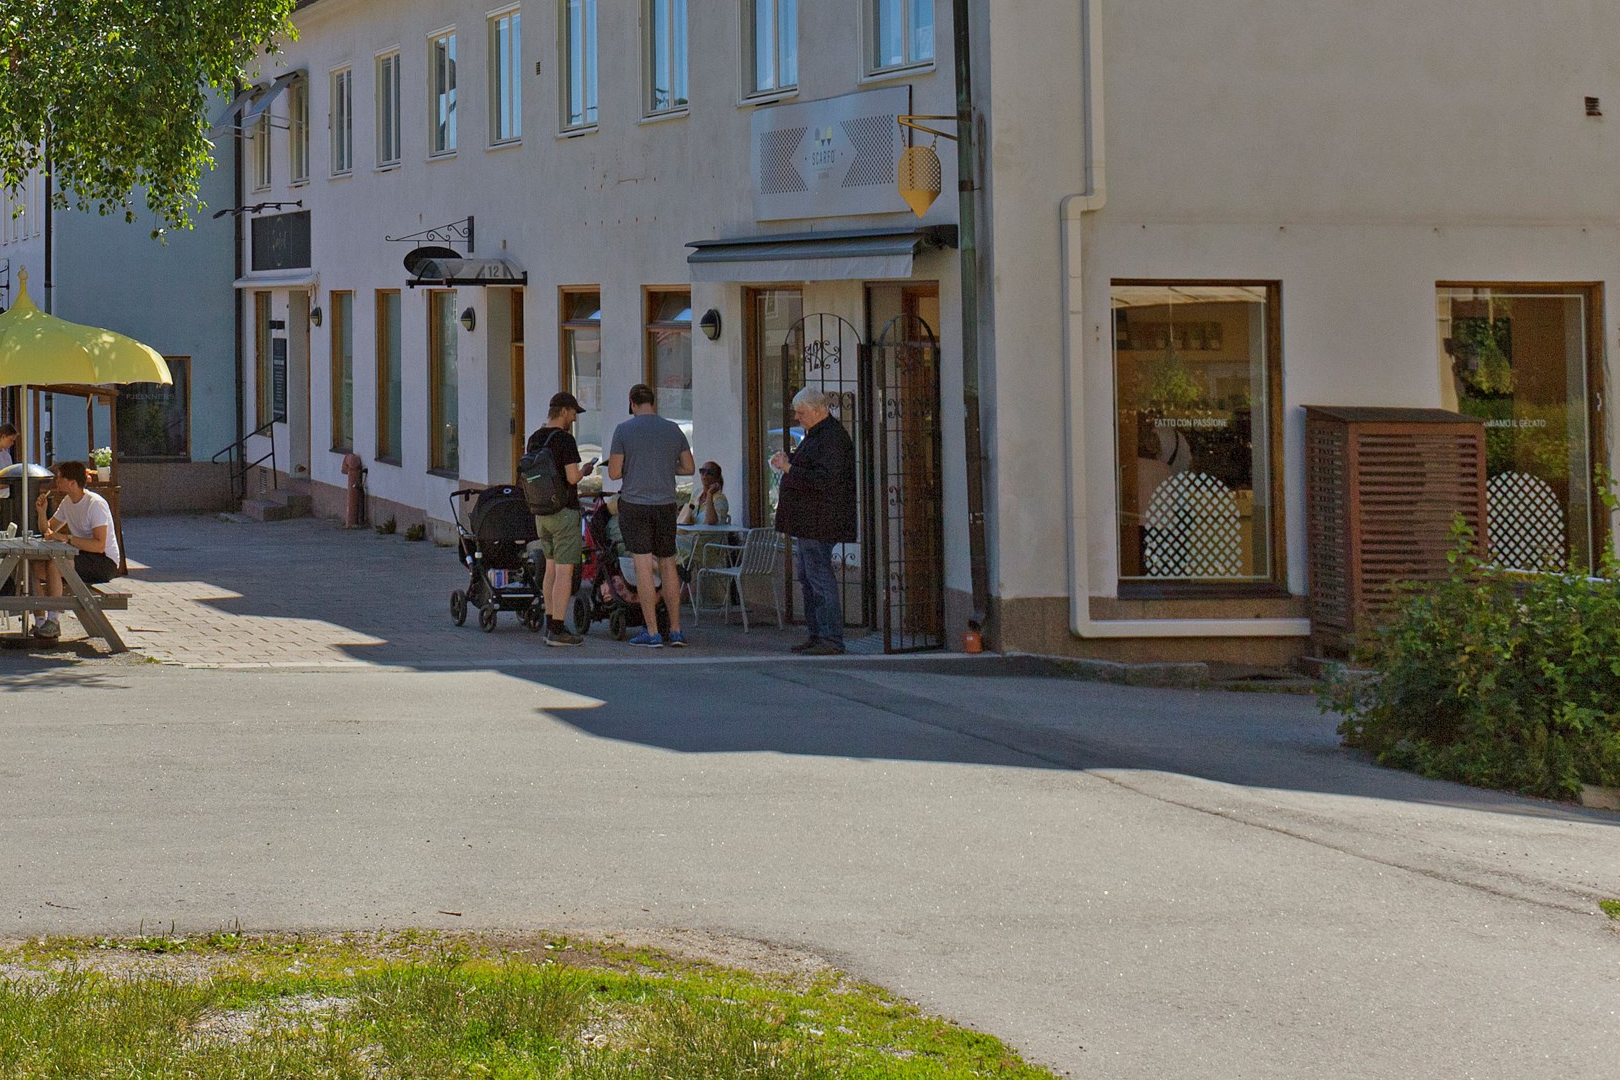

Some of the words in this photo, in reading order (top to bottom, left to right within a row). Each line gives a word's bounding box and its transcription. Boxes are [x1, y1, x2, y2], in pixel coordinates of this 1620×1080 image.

[488, 265, 499, 278] 12
[1154, 418, 1176, 427] FATTO
[1177, 418, 1192, 427] CON
[1193, 417, 1228, 427] PASSIONE
